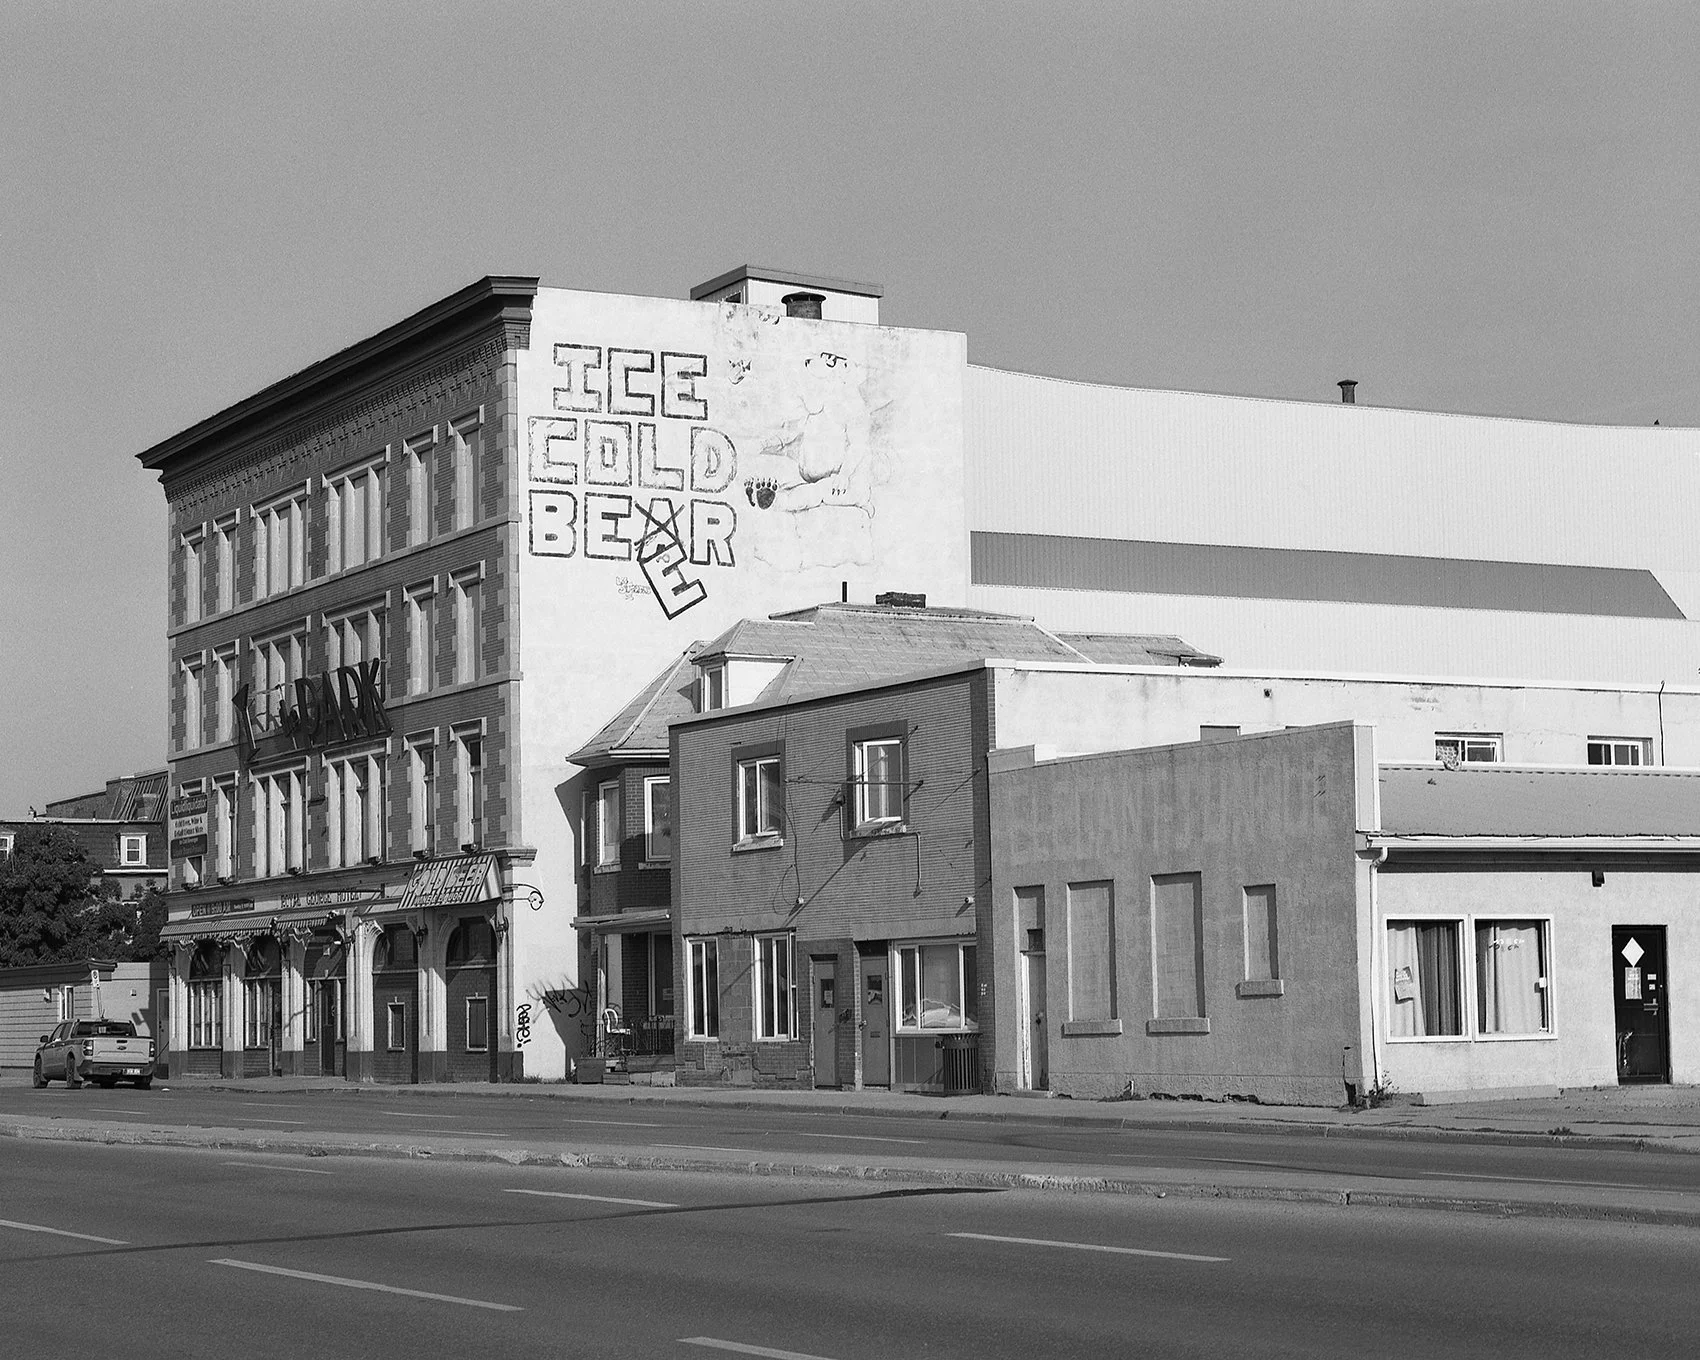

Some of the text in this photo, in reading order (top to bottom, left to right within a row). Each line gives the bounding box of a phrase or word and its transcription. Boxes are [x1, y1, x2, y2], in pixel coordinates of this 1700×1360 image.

[553, 343, 708, 421] ICE
[528, 416, 738, 493] COLD
[528, 489, 738, 567] BEAR
[444, 862, 488, 888] BEER
